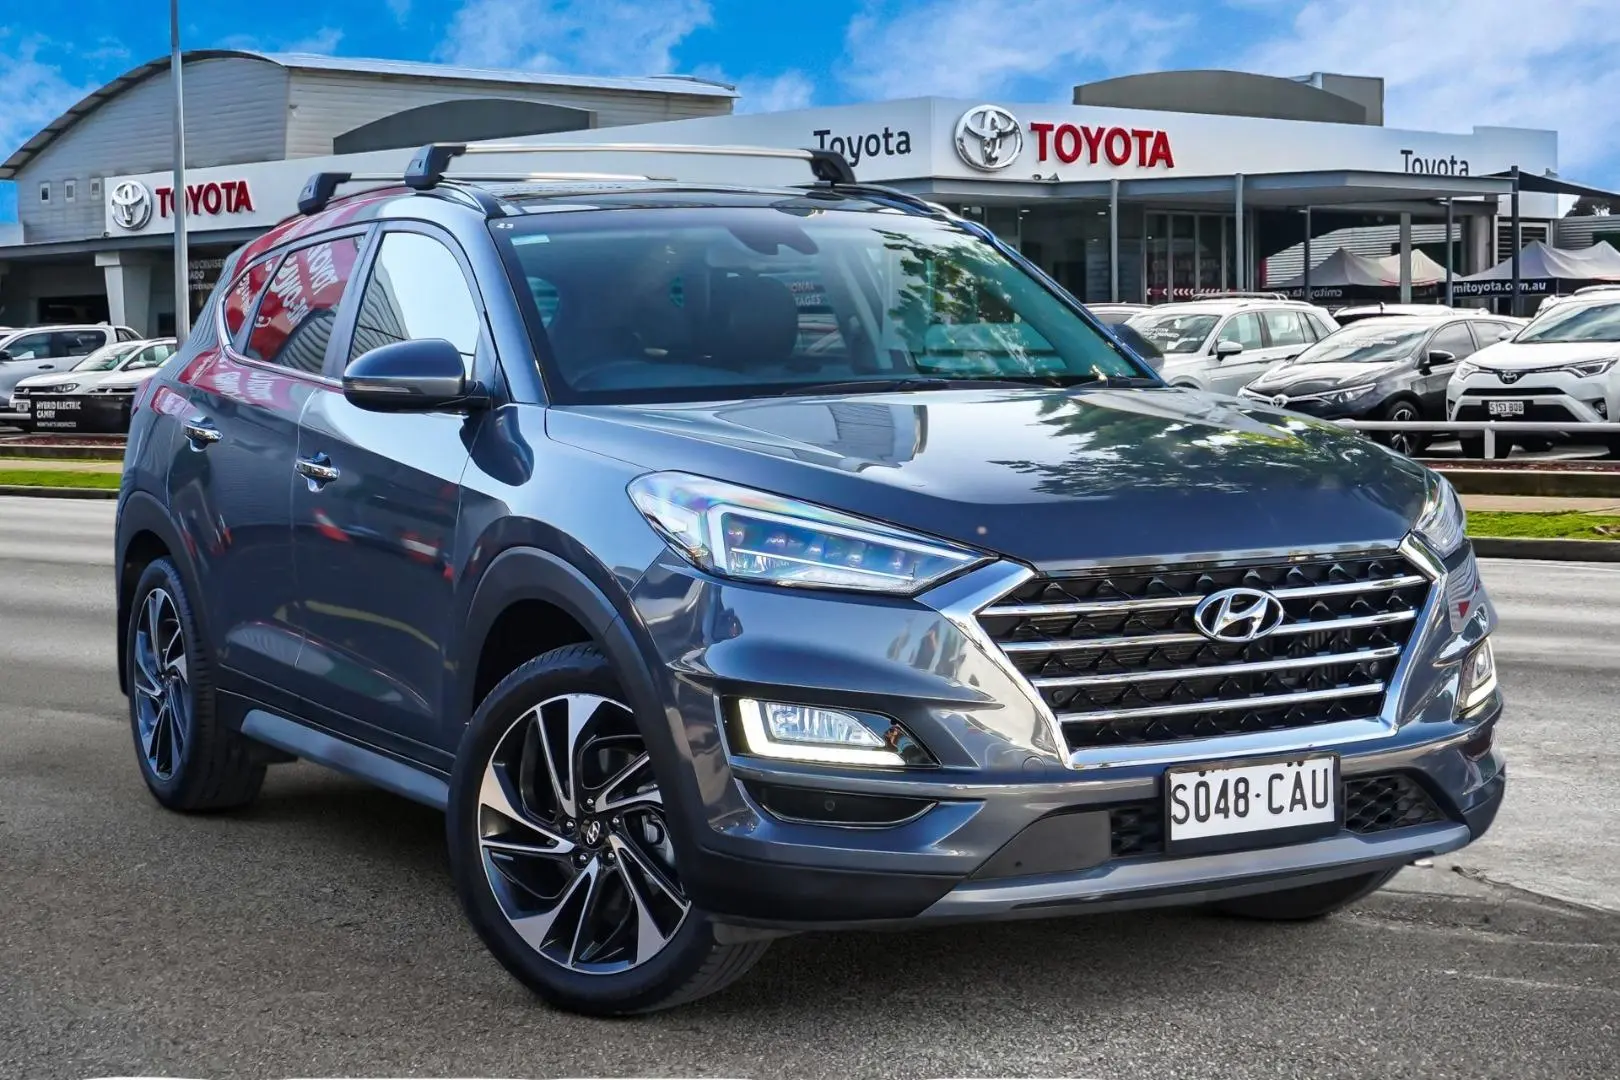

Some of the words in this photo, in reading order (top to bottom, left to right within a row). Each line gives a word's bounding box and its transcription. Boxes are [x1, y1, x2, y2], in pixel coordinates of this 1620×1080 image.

[813, 127, 911, 167] Toyota
[1030, 122, 1175, 168] TOYOTA
[56, 401, 81, 410] ELECTRIC
